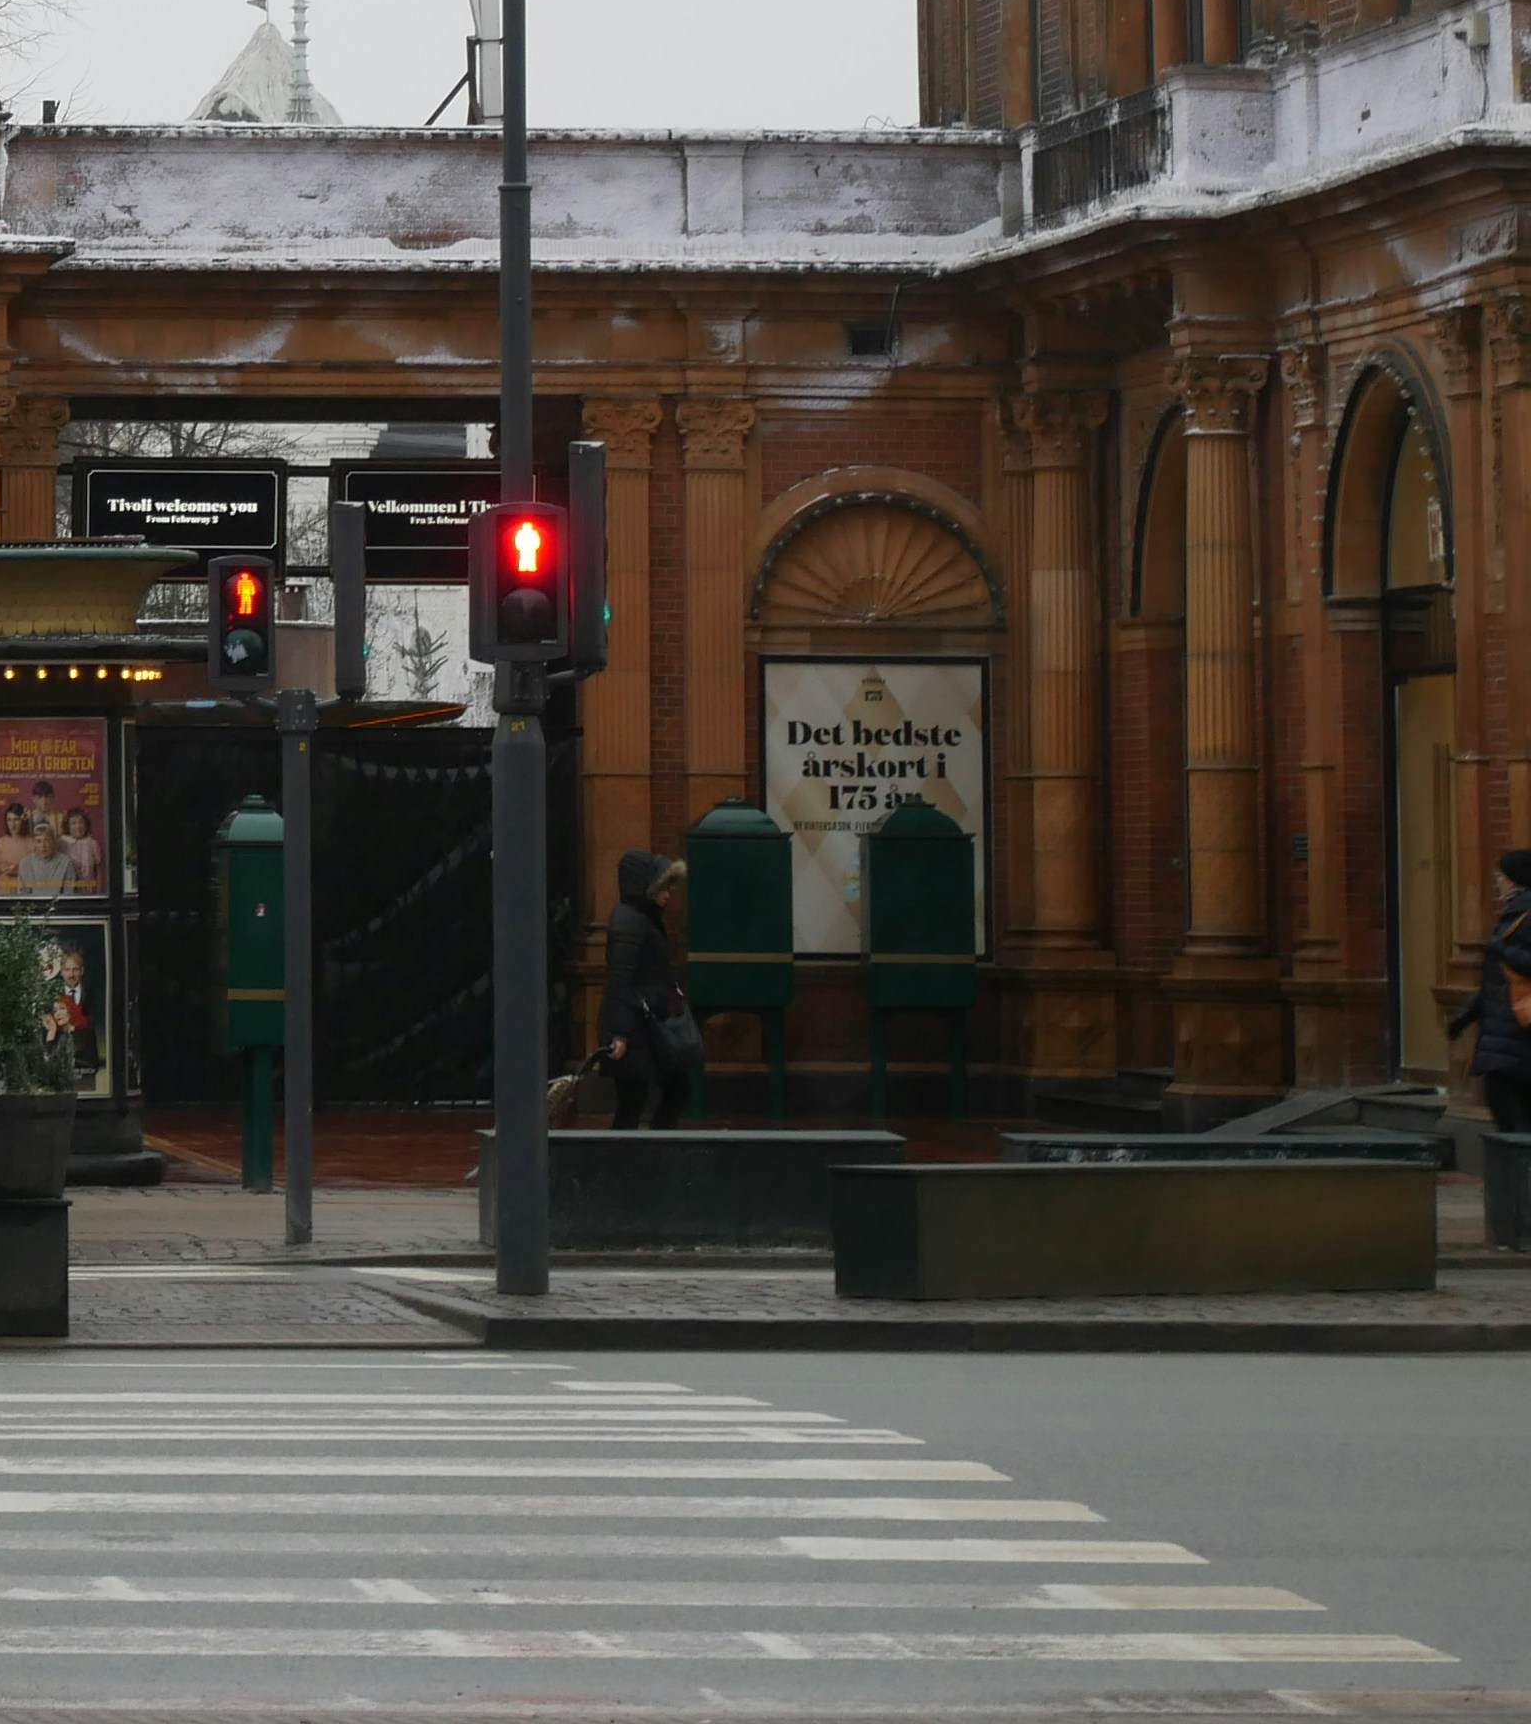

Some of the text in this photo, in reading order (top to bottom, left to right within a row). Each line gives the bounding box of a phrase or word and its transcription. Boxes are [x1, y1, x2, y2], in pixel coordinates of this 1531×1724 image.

[107, 498, 259, 516] Tivoli welcomes you
[367, 500, 458, 514] Velkommen
[787, 720, 962, 747] Det bedste
[802, 751, 947, 778] årskort i
[829, 785, 877, 810] 175
